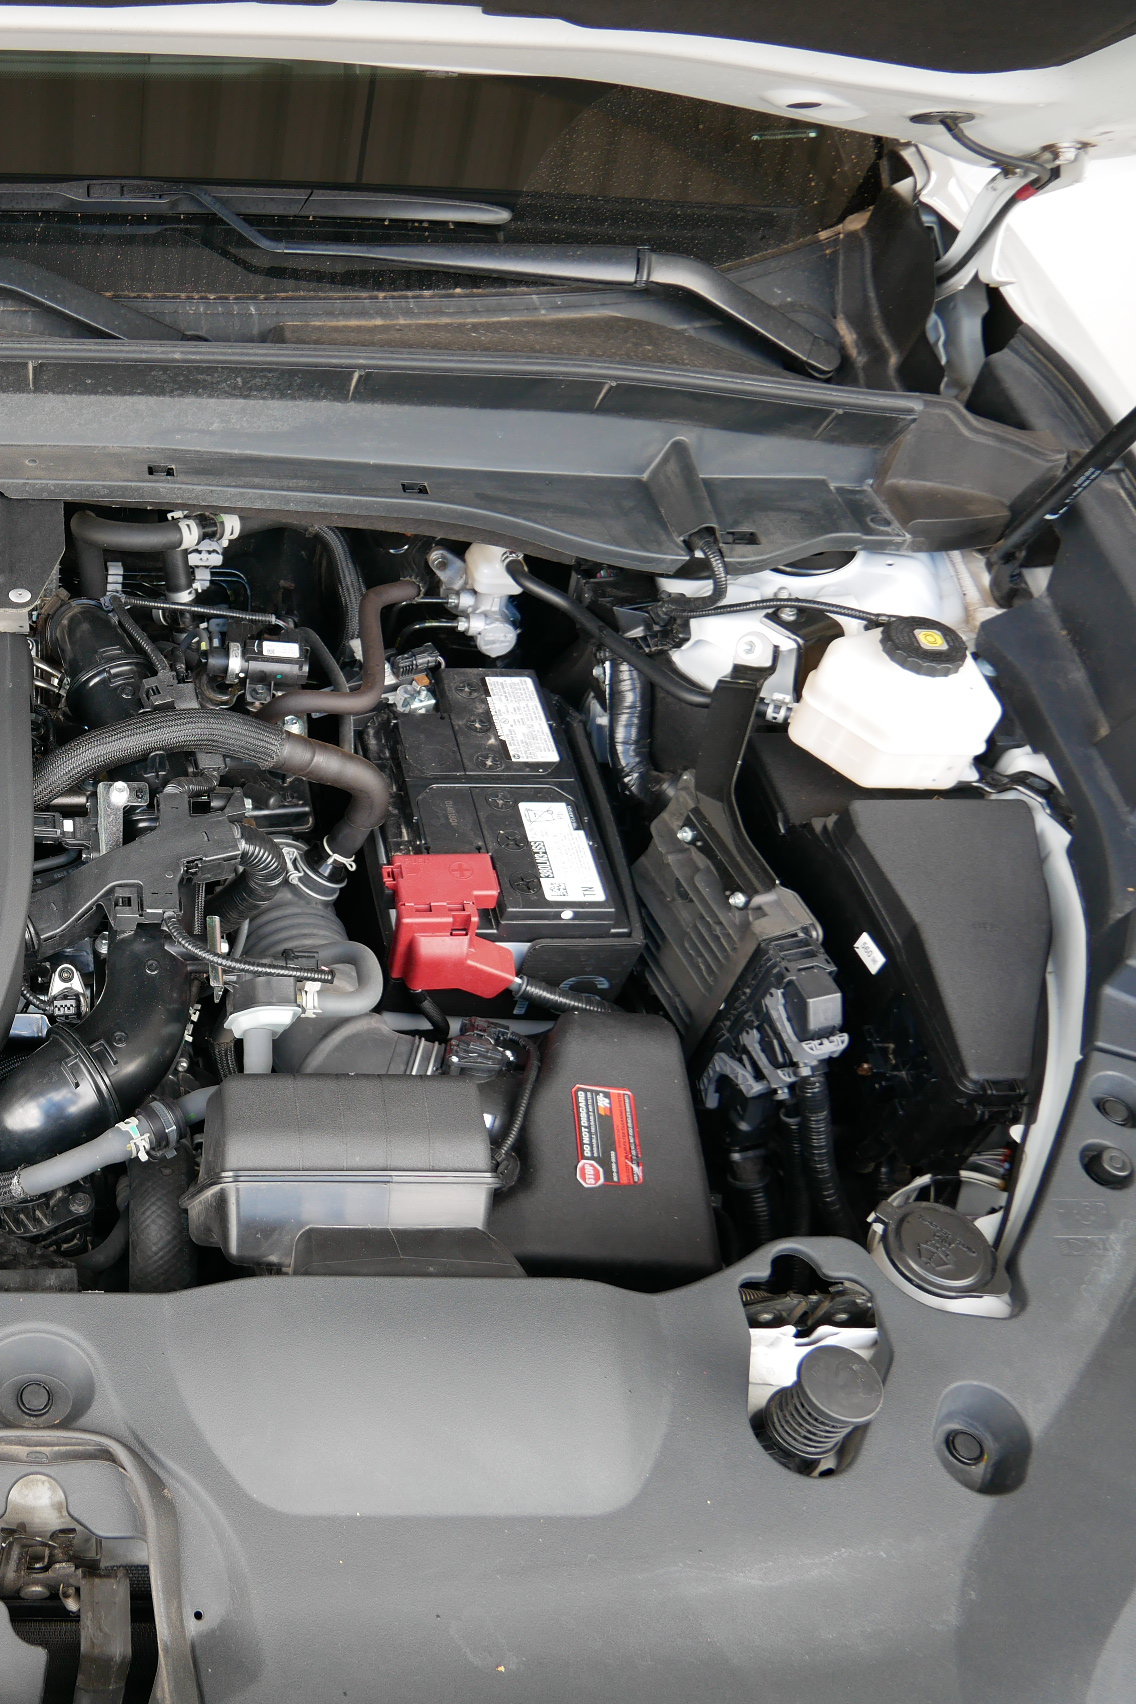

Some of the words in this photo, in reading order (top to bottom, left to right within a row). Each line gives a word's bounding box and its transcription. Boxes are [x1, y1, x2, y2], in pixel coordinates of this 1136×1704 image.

[577, 1091, 588, 1127] DISCARD
[581, 1127, 590, 1144] NOT
[583, 1144, 591, 1157] DO
[584, 1164, 595, 1184] STOP
